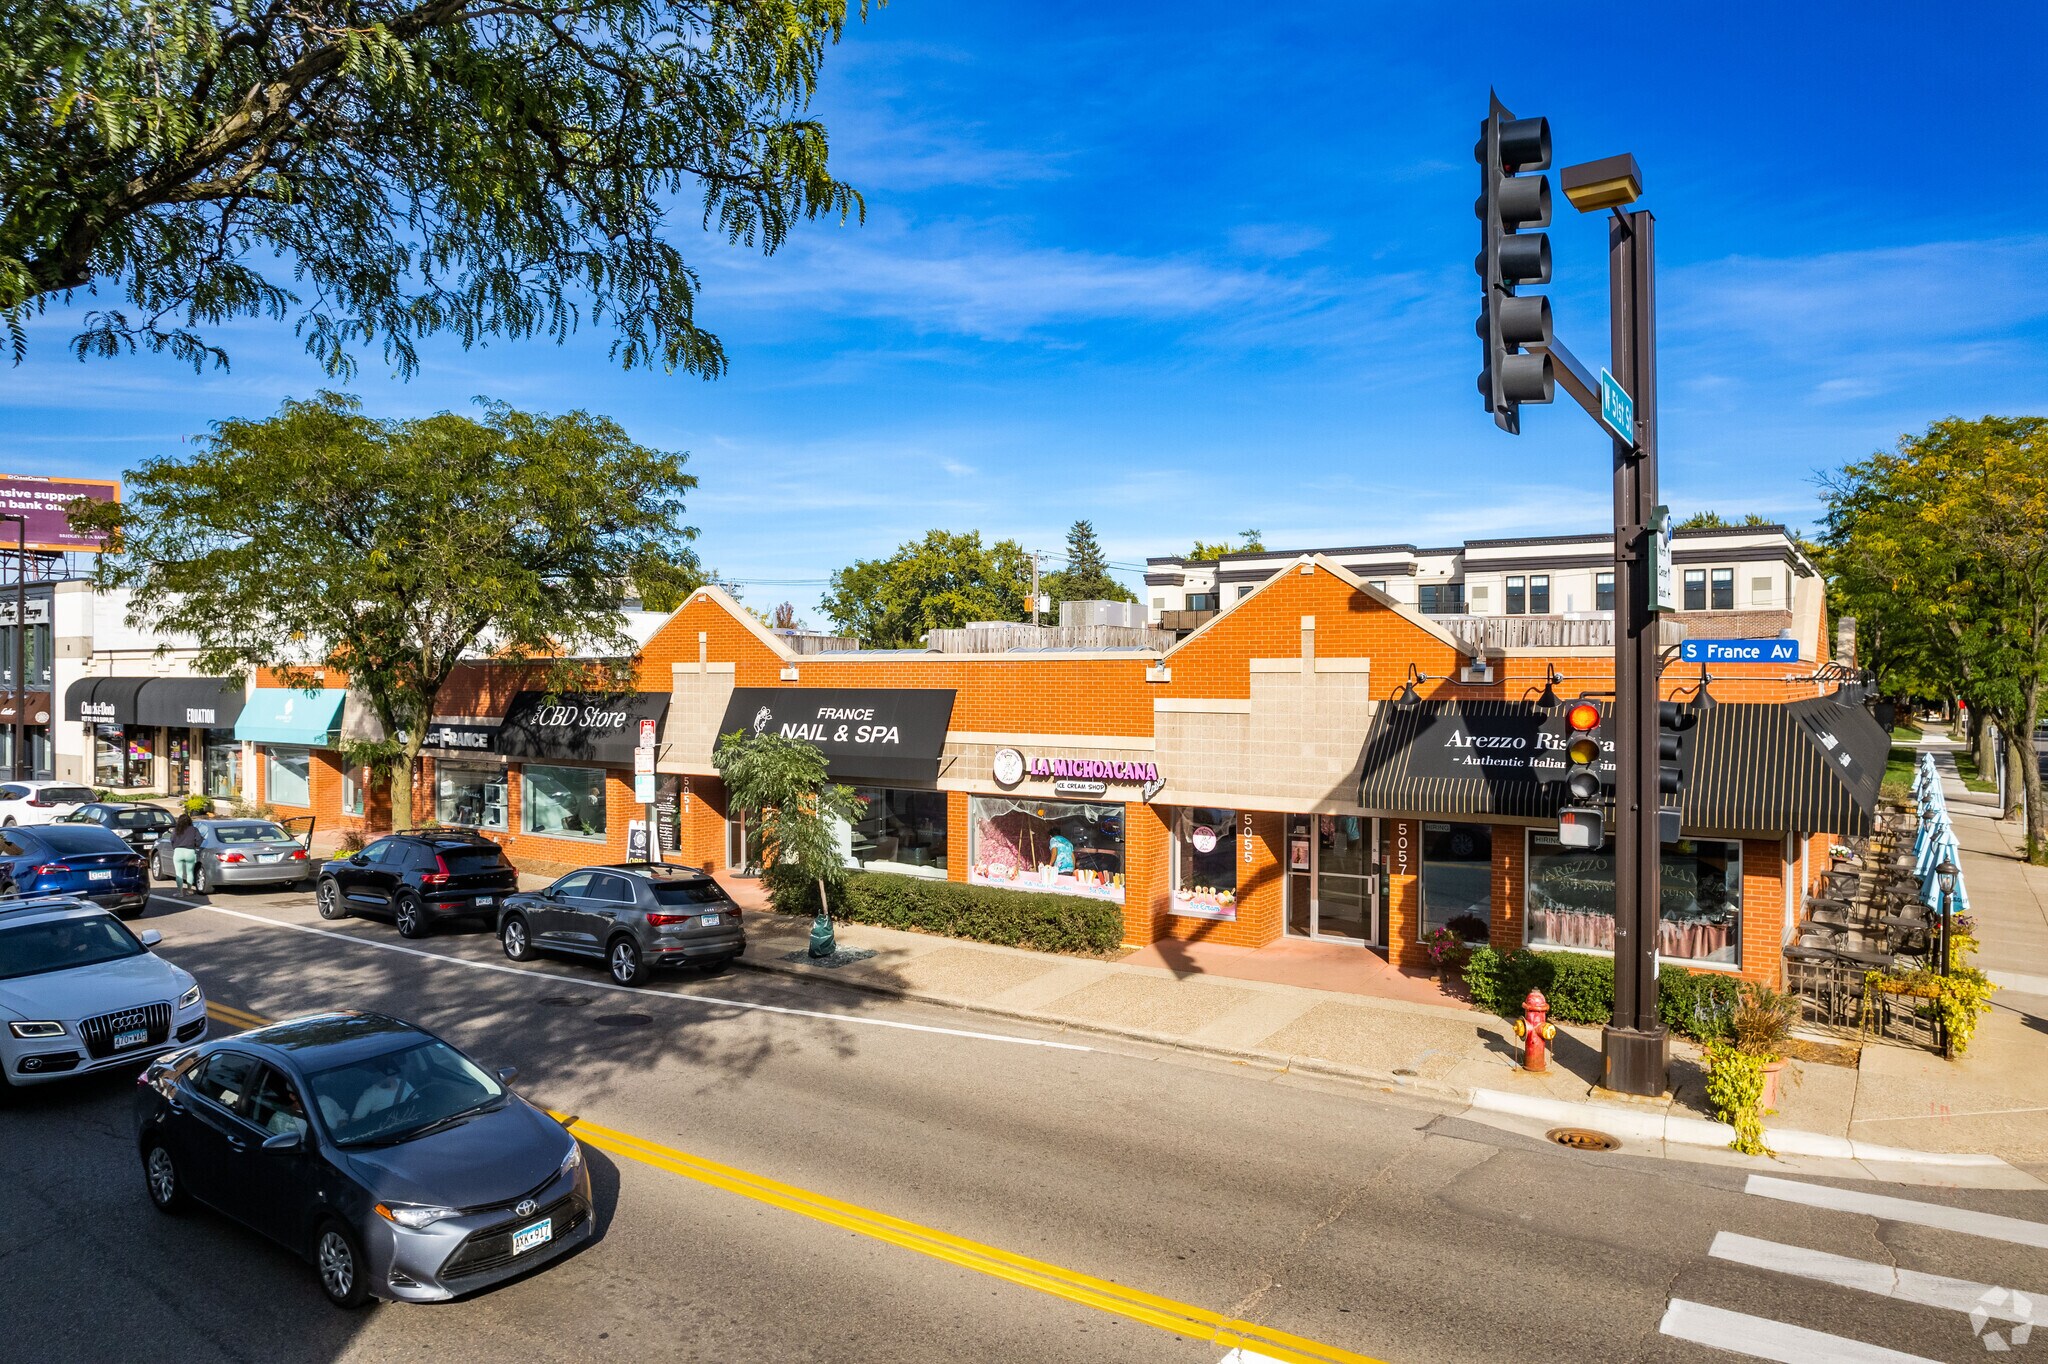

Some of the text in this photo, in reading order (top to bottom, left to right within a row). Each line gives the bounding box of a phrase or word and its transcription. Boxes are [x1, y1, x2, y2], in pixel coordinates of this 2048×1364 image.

[1603, 381, 1632, 434] W 51st St
[9, 500, 42, 510] bank
[34, 491, 86, 501] support
[1686, 644, 1793, 659] S France Av
[186, 708, 215, 723] EQUATION
[530, 704, 544, 725] YOUR
[539, 705, 627, 728] CBD Store
[817, 708, 874, 720] FRANCE
[440, 727, 488, 748] FRANCE
[780, 723, 899, 744] NAIL & SPA
[1444, 729, 1526, 749] Arezzo
[1031, 758, 1157, 780] LA MICHOACANA
[1462, 755, 1524, 767] Authentic
[1067, 782, 1086, 790] CREAM
[1243, 813, 1253, 863] 5055
[1398, 823, 1408, 876] 5057
[1543, 859, 1607, 881] AREZZO
[1201, 902, 1220, 912] Cream
